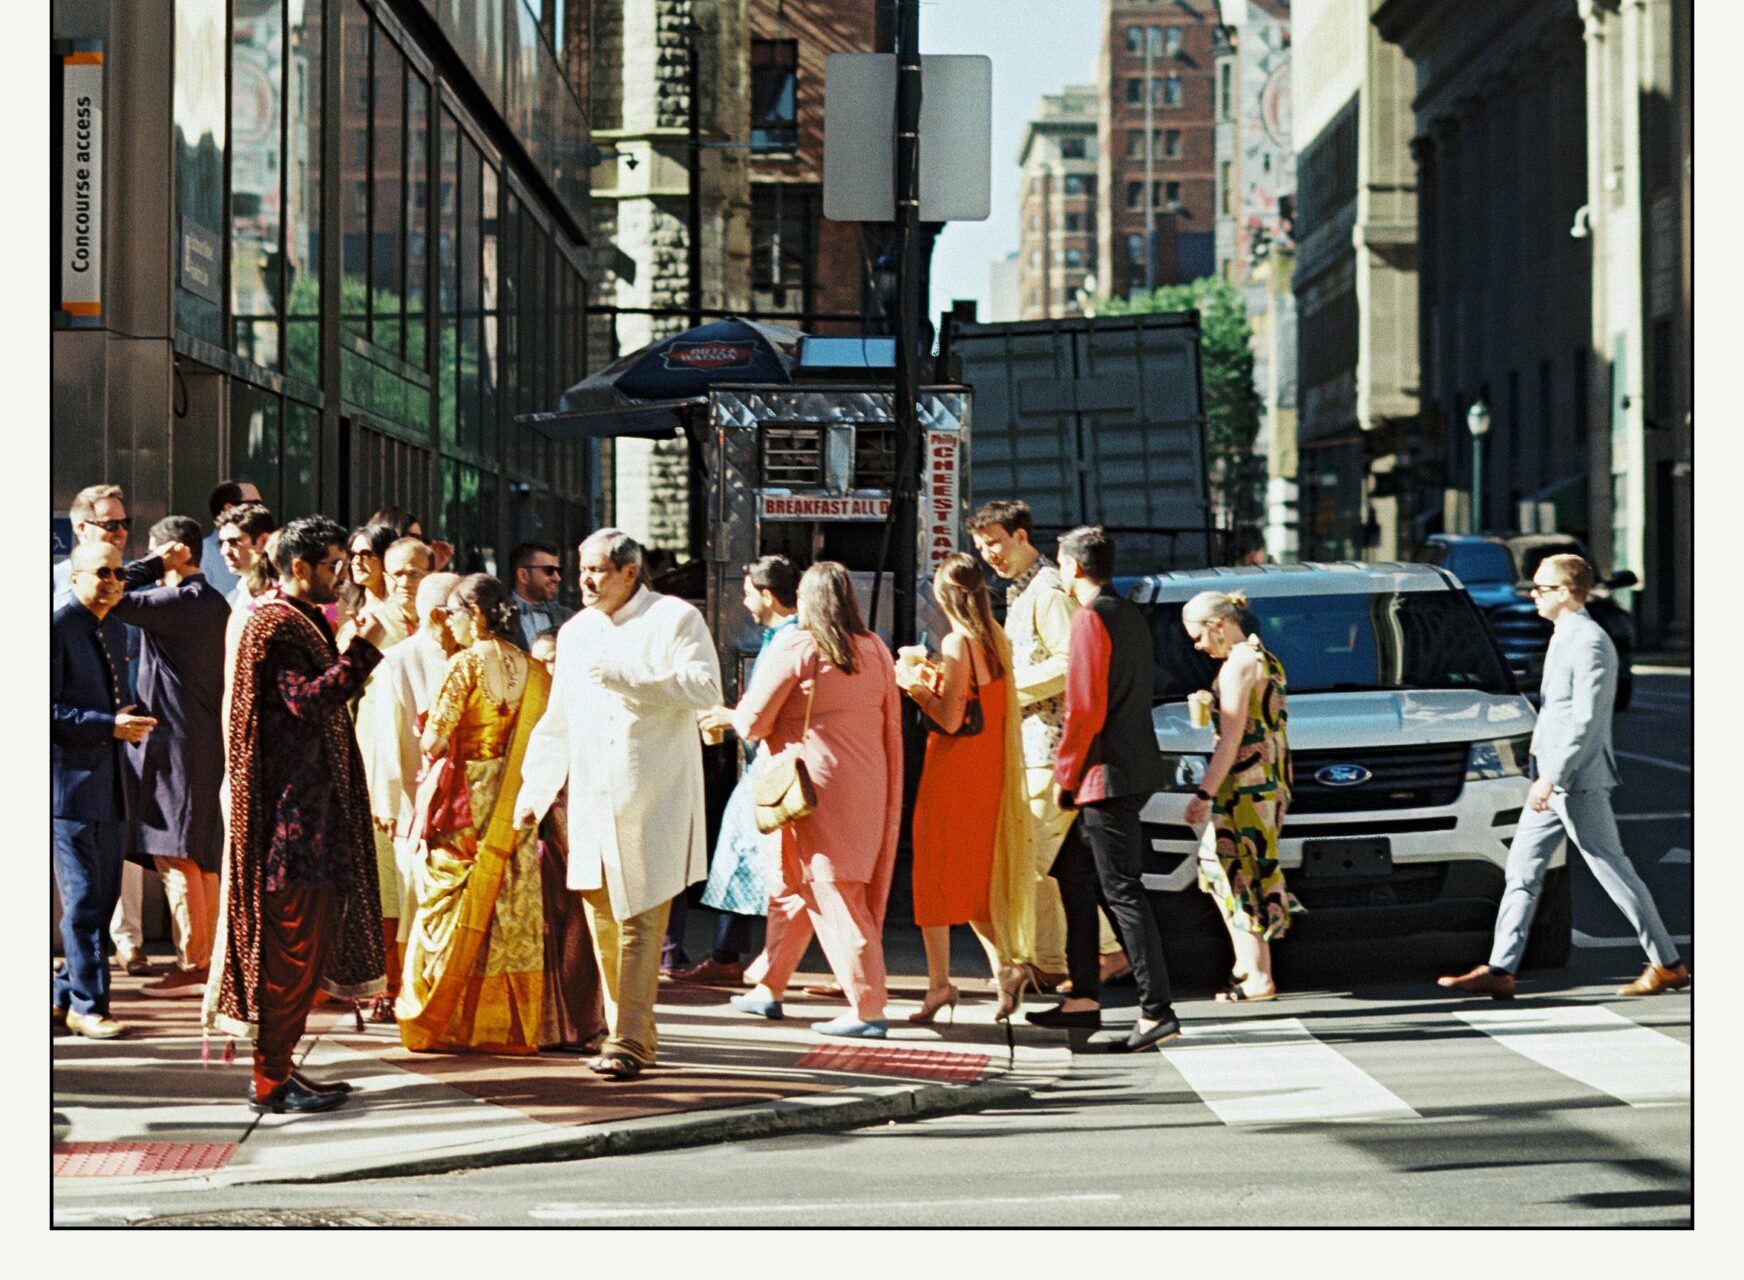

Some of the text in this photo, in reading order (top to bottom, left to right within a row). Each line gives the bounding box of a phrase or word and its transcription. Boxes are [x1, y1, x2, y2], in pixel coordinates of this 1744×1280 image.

[71, 95, 91, 273] Concourse access
[765, 500, 849, 514] BREAKFAST
[852, 500, 875, 514] ALL
